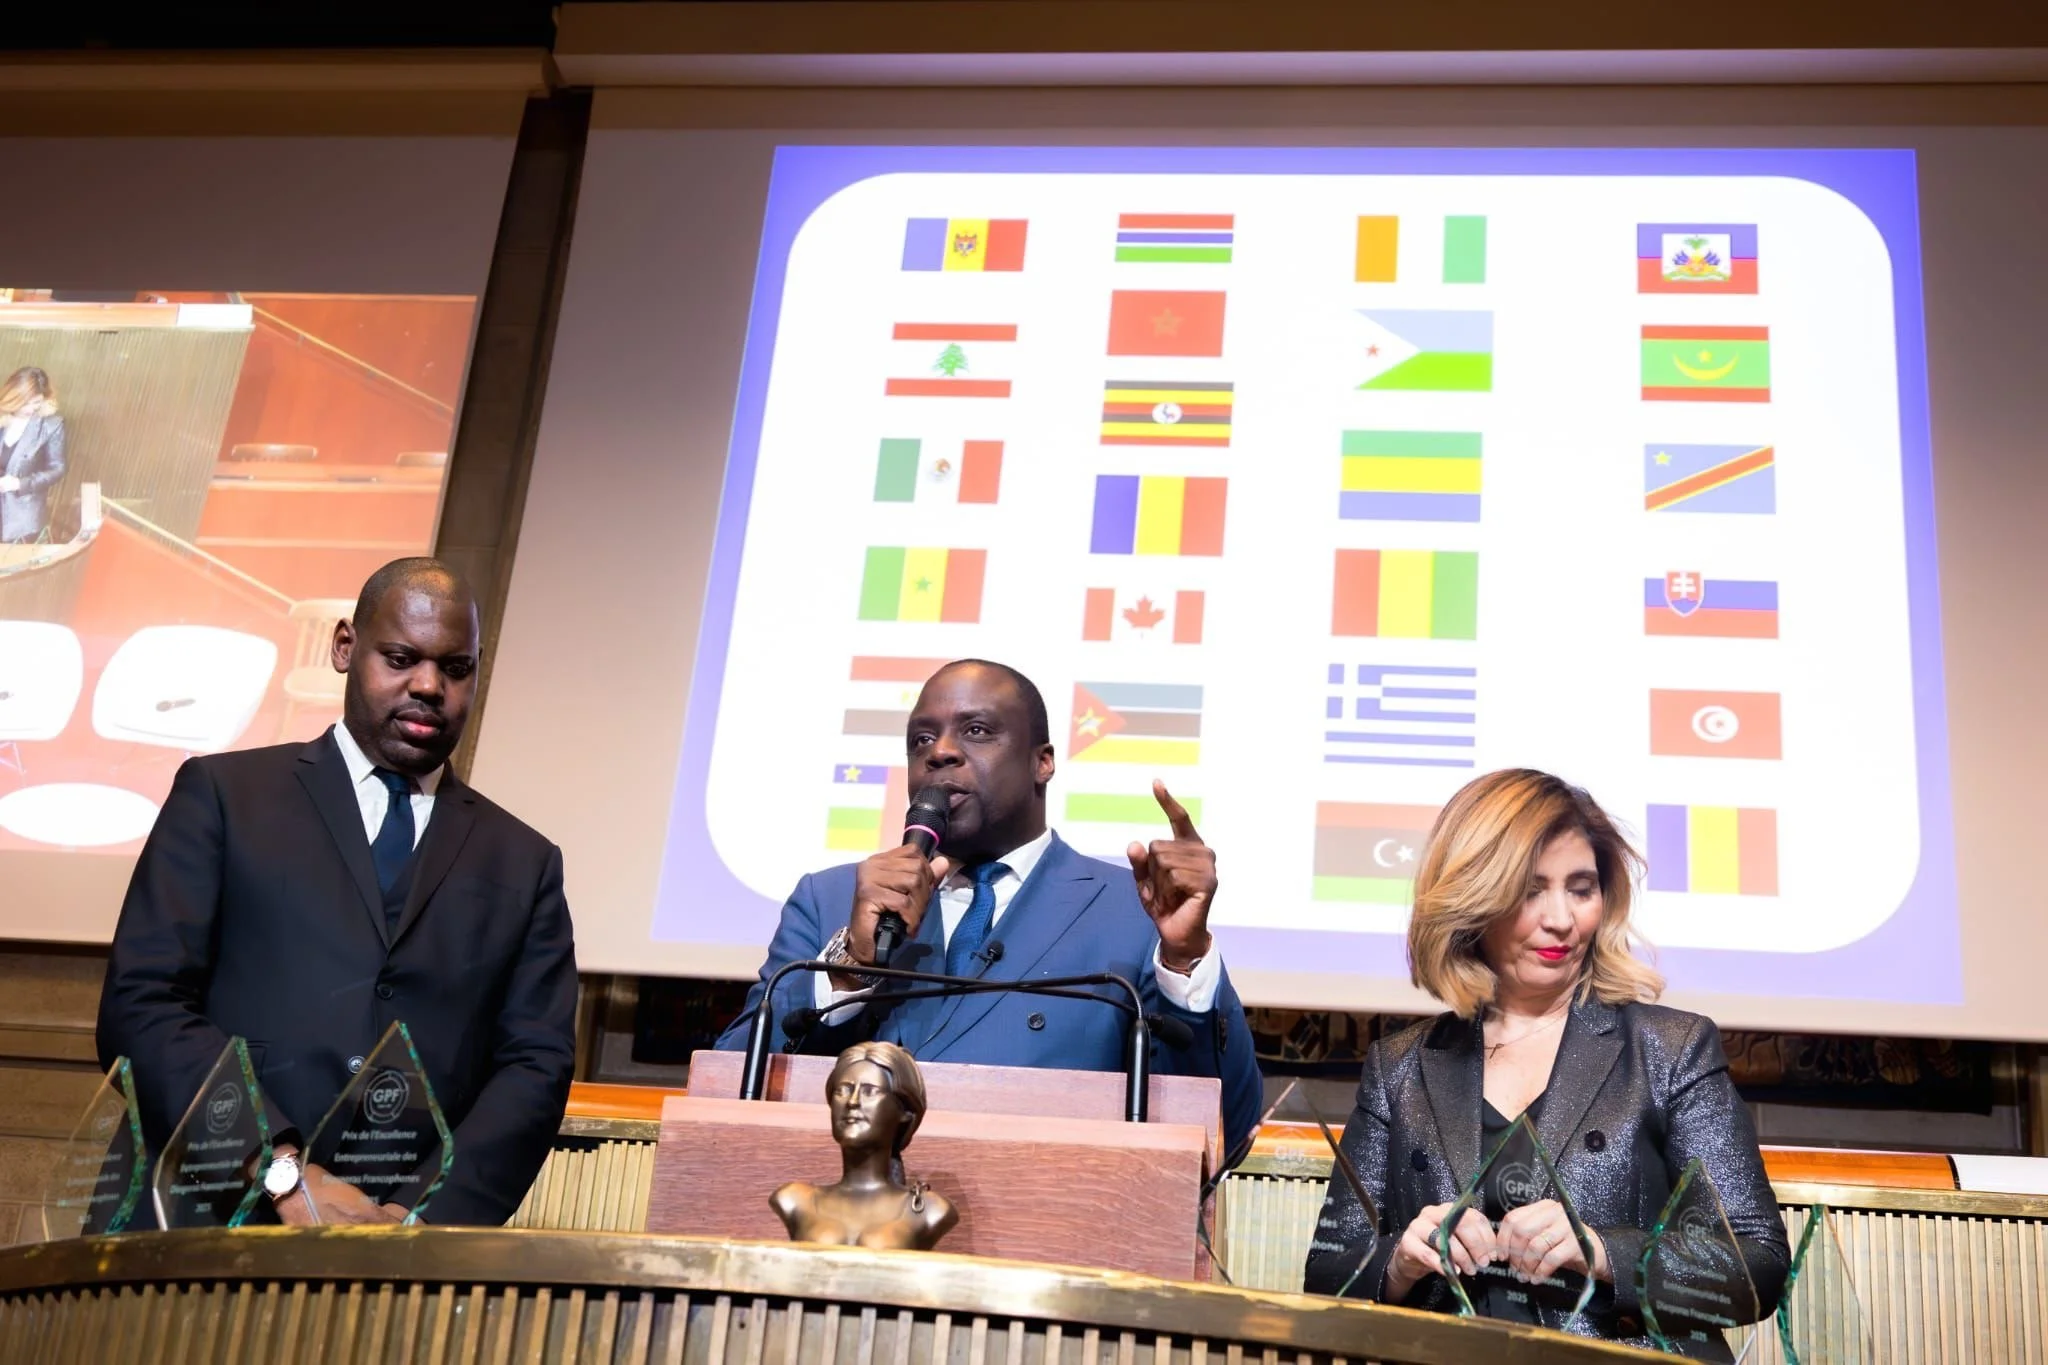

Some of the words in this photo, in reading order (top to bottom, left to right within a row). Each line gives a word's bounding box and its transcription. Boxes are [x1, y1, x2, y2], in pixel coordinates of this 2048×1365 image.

[372, 1088, 401, 1103] GPF
[213, 1099, 236, 1114] GPF
[341, 1130, 358, 1140] Prix
[358, 1130, 370, 1140] de
[1505, 1179, 1534, 1198] GPF
[1319, 1217, 1338, 1229] des
